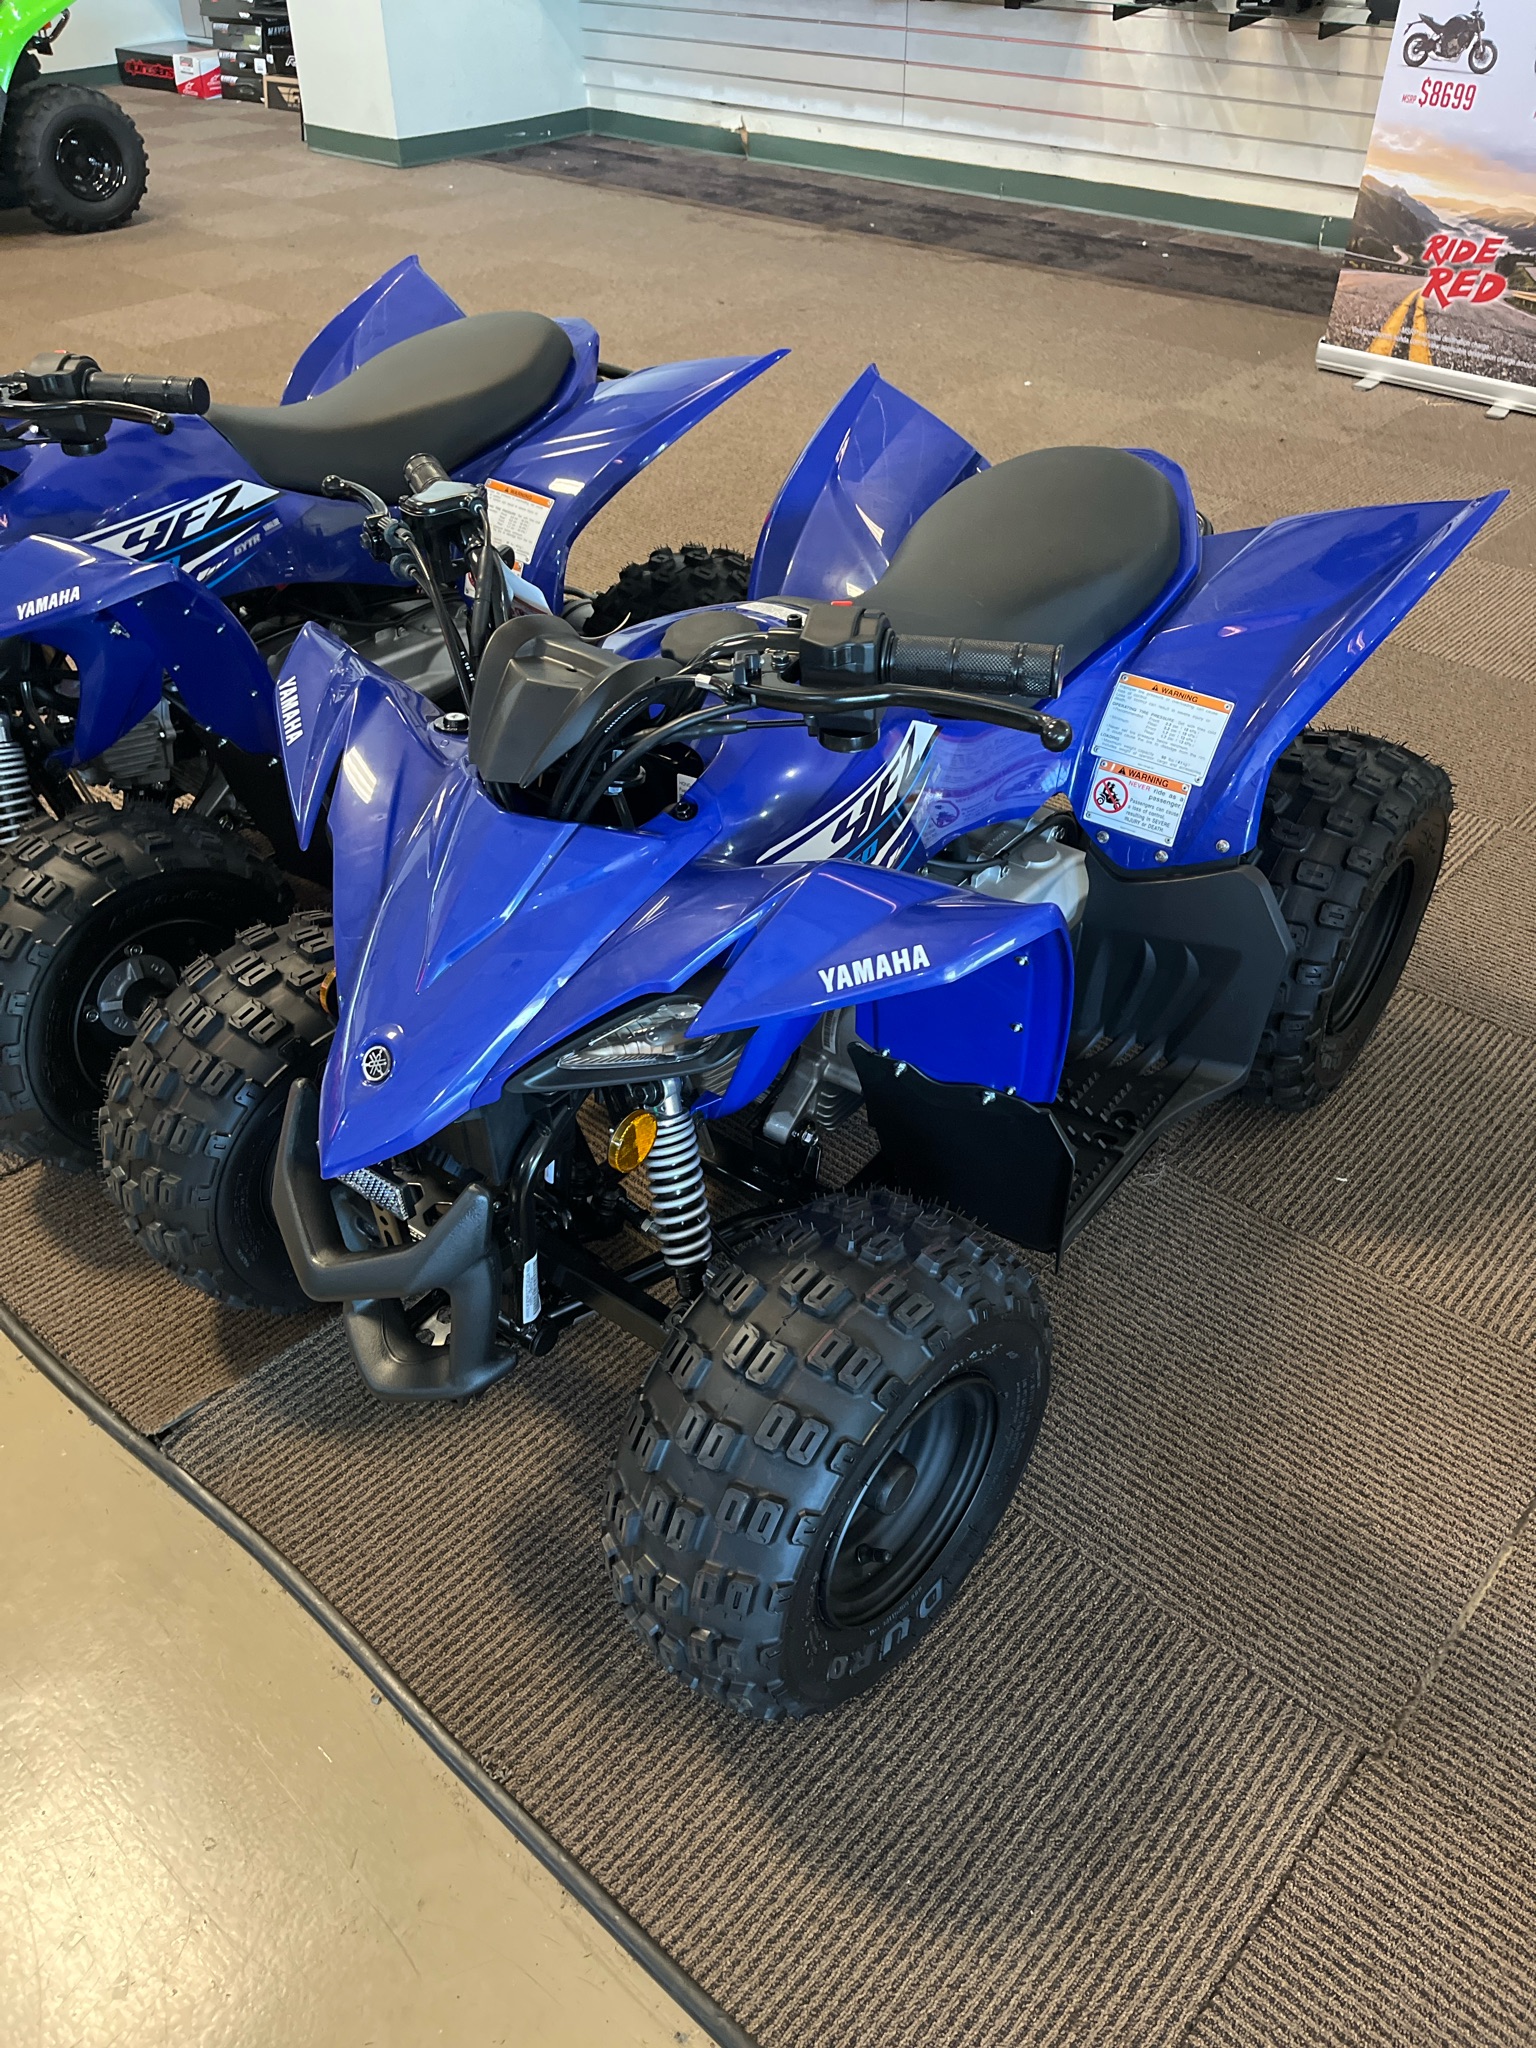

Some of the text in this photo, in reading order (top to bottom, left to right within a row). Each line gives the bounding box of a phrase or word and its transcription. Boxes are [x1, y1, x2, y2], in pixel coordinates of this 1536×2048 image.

[1401, 77, 1477, 111] MSRP $8699
[1422, 234, 1505, 266] RIDE
[1421, 267, 1507, 309] RED
[234, 532, 261, 557] GYTR
[17, 585, 81, 621] YAMAHA
[278, 675, 304, 747] YAMAHA
[1161, 687, 1199, 703] WARNING
[1128, 769, 1169, 788] WARNING
[1129, 781, 1150, 791] NEVER
[1126, 810, 1145, 820] resulting
[1152, 819, 1170, 827] SEVERE
[1129, 798, 1154, 810] Passengers
[817, 944, 931, 994] YAMAHA
[826, 1575, 944, 1683] DURO
